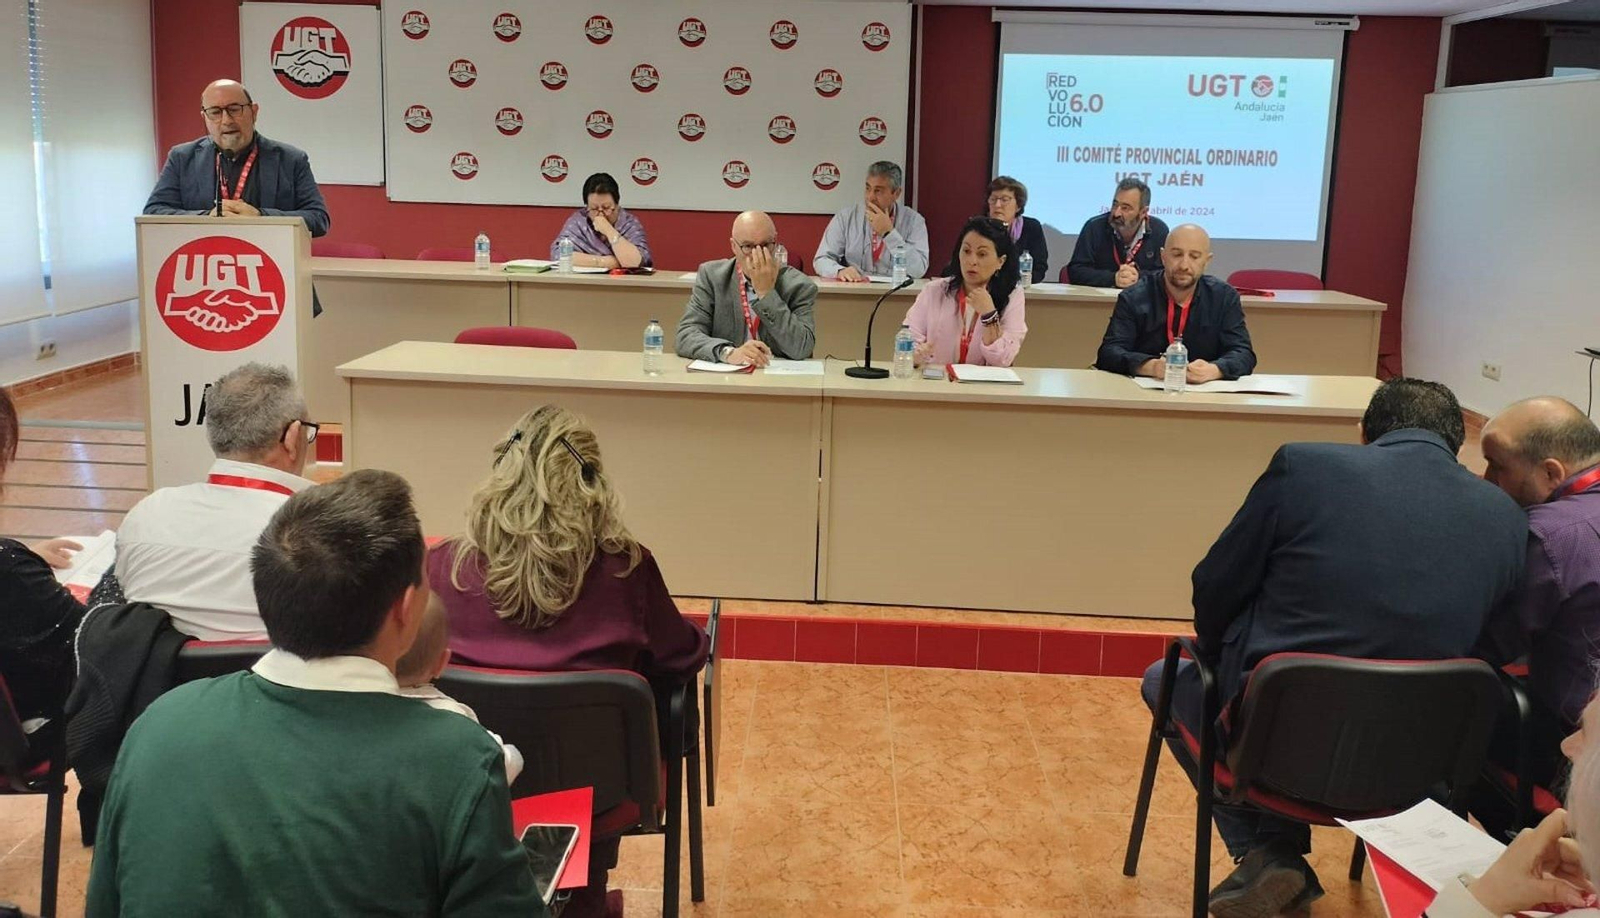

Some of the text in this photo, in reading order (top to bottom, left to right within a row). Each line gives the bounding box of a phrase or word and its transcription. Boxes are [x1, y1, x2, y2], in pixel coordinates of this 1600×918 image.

[406, 14, 426, 24] UGT
[498, 17, 517, 27] UGT
[590, 19, 608, 29] UGT
[684, 22, 702, 32] UGT
[775, 24, 794, 34] UGT
[868, 26, 886, 36] UGT
[282, 27, 337, 54] UGT
[454, 63, 473, 73] UGT
[544, 66, 564, 76] UGT
[637, 68, 656, 78] UGT
[728, 70, 748, 80] UGT
[821, 72, 840, 82] UGT
[1048, 75, 1077, 88] RED
[1187, 74, 1247, 97] UGT
[1048, 89, 1068, 102] VO
[1048, 102, 1066, 114] LU
[1070, 93, 1104, 113] 6.0
[408, 108, 428, 118] UGT
[501, 111, 520, 121] UGT
[590, 114, 609, 124] UGT
[684, 117, 702, 127] UGT
[774, 119, 792, 129] UGT
[1047, 112, 1082, 128] CIÓN
[864, 120, 883, 130] UGT
[456, 155, 474, 165] UGT
[1057, 143, 1278, 167] III COMITÉ PROVINCIAL ORDINARIO
[544, 157, 563, 168] UGT
[636, 162, 654, 172] UGT
[727, 164, 746, 174] UGT
[818, 165, 836, 175] UGT
[1157, 170, 1204, 187] JAÉN
[1151, 206, 1173, 216] abril
[1174, 206, 1187, 216] de
[1190, 207, 1215, 216] 2024
[173, 254, 264, 295] UGT
